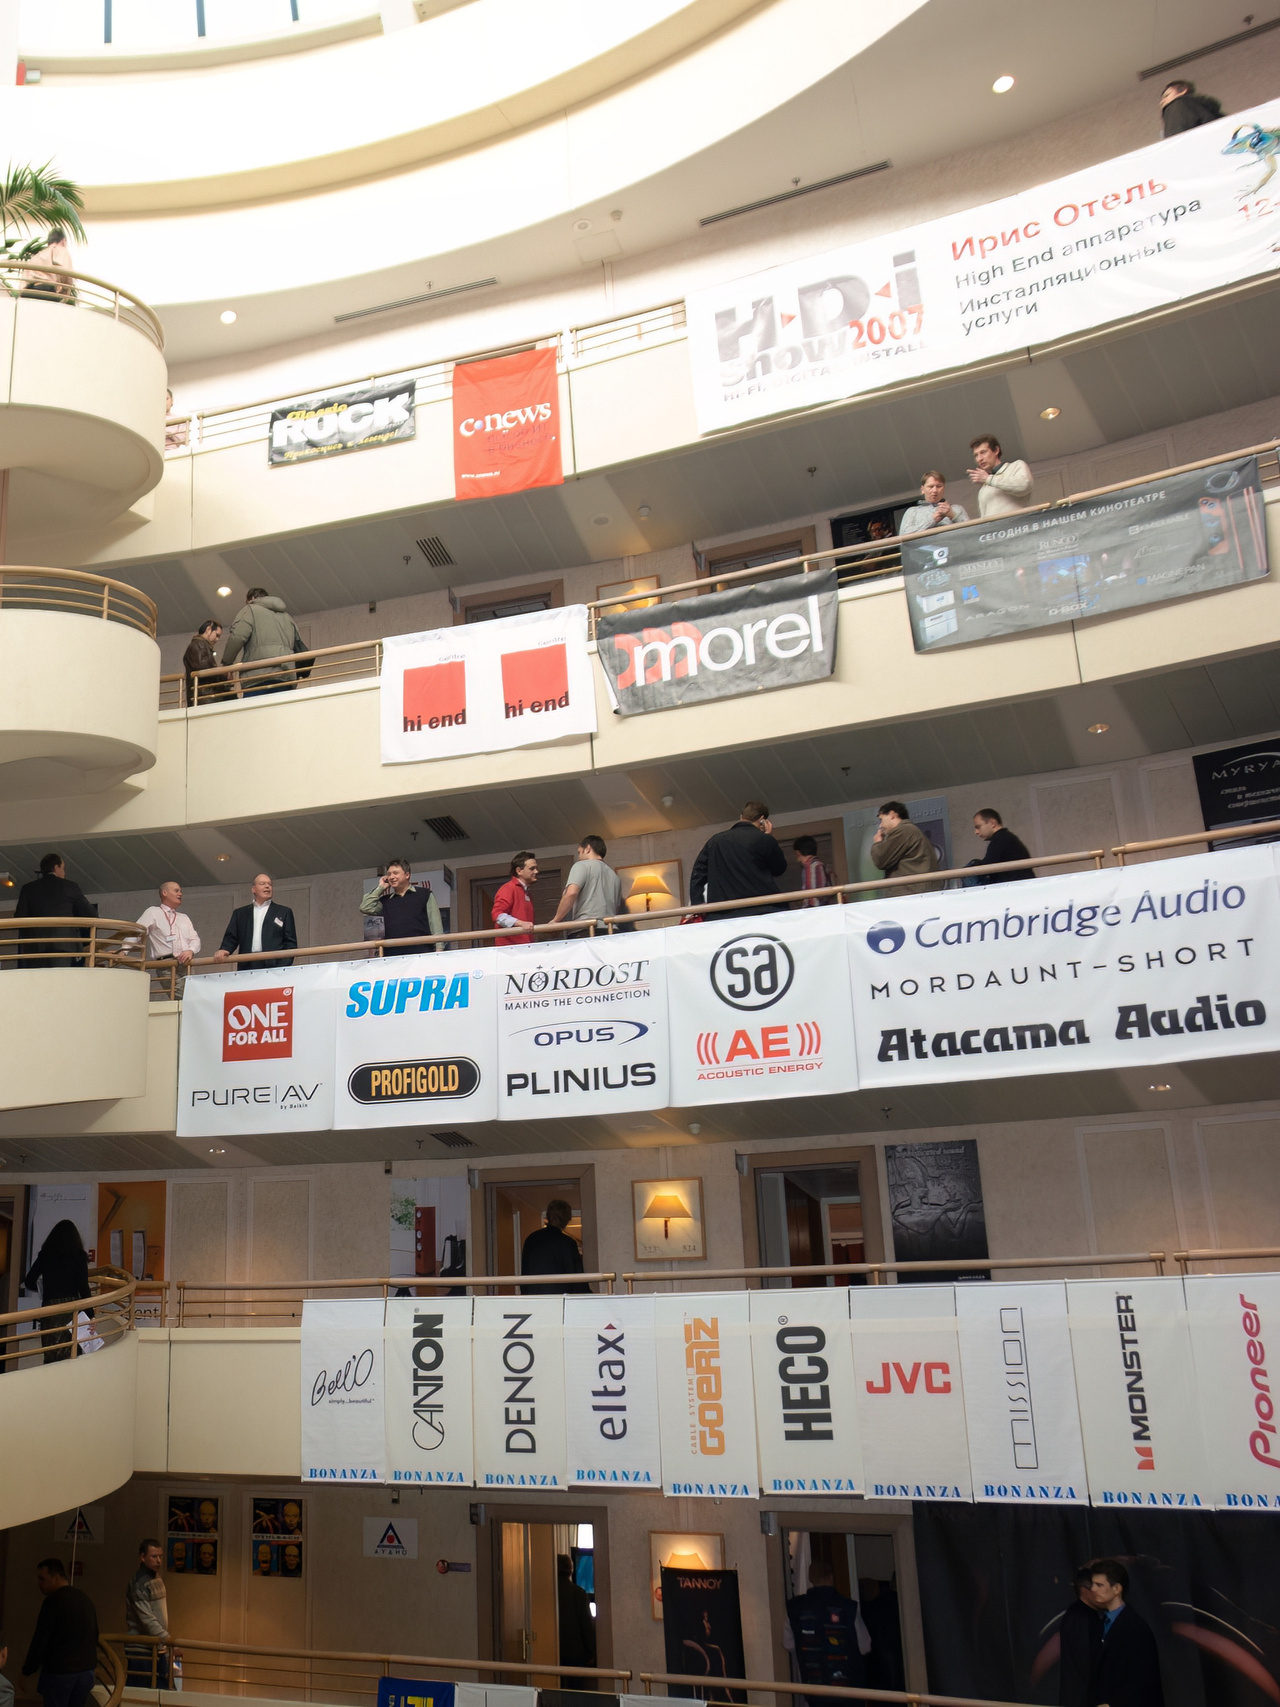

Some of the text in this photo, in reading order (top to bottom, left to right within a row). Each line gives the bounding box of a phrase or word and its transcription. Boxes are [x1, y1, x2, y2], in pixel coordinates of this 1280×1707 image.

[951, 178, 1168, 263] Ирис Отель
[955, 198, 1203, 292] High End аппаратура
[959, 237, 1177, 315] Инсталляционные
[848, 304, 925, 350] 2007
[962, 300, 1039, 337] услуги
[272, 391, 411, 448] ROCK
[979, 524, 1029, 543] СЕГОДНЯ
[1042, 511, 1088, 528] НАШЕМ
[1090, 490, 1167, 517] КИНОТЕАТРЕ
[634, 594, 824, 687] morel
[403, 708, 467, 733] hi end
[505, 690, 570, 719] hi end
[916, 879, 1247, 950] Cambridge Audio
[871, 938, 1256, 1000] MORDAUNT-SHORT
[346, 972, 470, 1019] SUPRA
[505, 989, 651, 1011] MAKING THE CONNECTION
[227, 1001, 289, 1031] ONE
[877, 993, 1268, 1063] Atacama Audio
[228, 1028, 287, 1047] FOR ALL
[533, 1027, 616, 1047] OPUS
[371, 1064, 459, 1097] PROFIGOLD
[507, 1062, 656, 1097] PLINIUS
[696, 1061, 824, 1082] ACOUSTIC ENERGY
[412, 1313, 445, 1451] CANTON
[502, 1313, 537, 1454] DENON
[775, 1325, 835, 1441] HECO
[866, 1362, 952, 1394] JVC
[1116, 1294, 1152, 1442] MONSTER
[1239, 1293, 1280, 1469] Pioneer
[591, 1332, 628, 1441] eltax
[309, 1468, 378, 1480] BONANZA
[393, 1470, 465, 1483] BONANZA
[485, 1473, 559, 1486] BONANZA
[576, 1469, 652, 1482] BONANZA
[672, 1482, 750, 1496] BONANZA
[772, 1479, 856, 1492] BONANZA
[874, 1484, 962, 1498] BONANZA
[983, 1484, 1077, 1499] BONANZA
[1102, 1491, 1203, 1507] BONANZA
[677, 1576, 723, 1590] TANNOY
